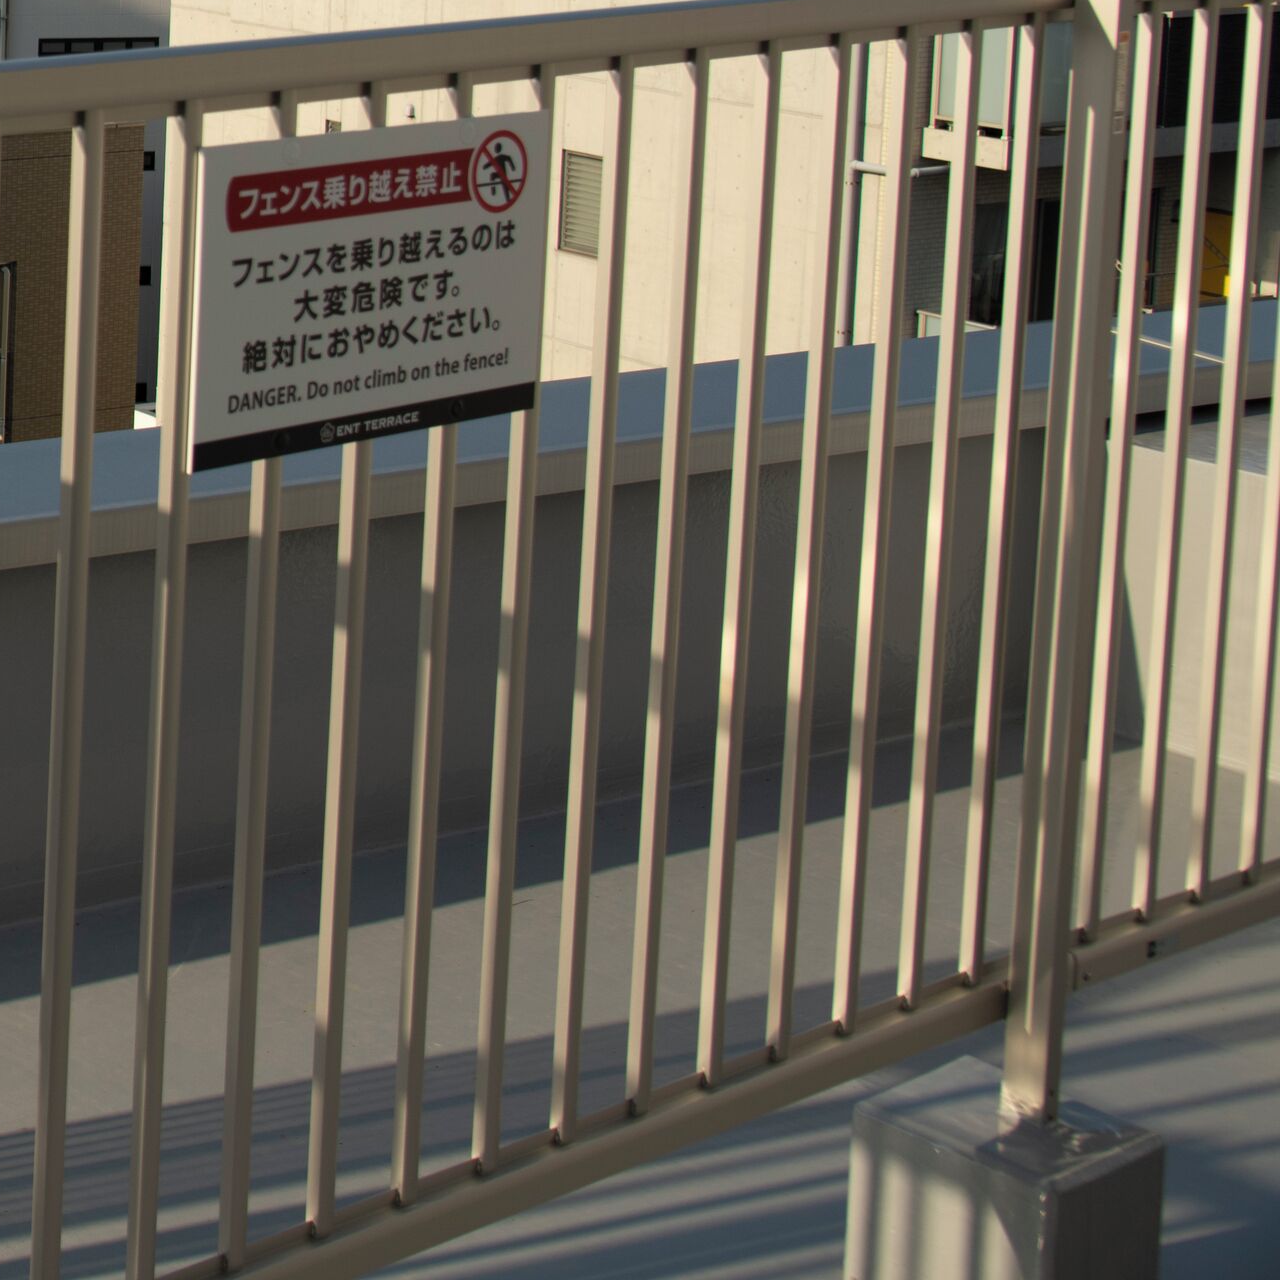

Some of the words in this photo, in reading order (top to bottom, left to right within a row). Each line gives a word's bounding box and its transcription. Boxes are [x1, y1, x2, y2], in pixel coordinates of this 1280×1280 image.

[239, 162, 462, 220] フェンス乗り越え禁止
[232, 220, 516, 288] フェンスを乗り越えるのは
[293, 269, 461, 323] 大変危険です。
[242, 306, 501, 375] 絶対におやめください。
[227, 385, 302, 414] DANGER.
[307, 380, 329, 400] Do
[333, 375, 360, 396] not
[364, 366, 407, 390] climb
[411, 365, 431, 381] on
[434, 356, 460, 379] the
[463, 347, 510, 372] fence!
[336, 422, 361, 438] ENT
[364, 411, 420, 432] TERRACE
